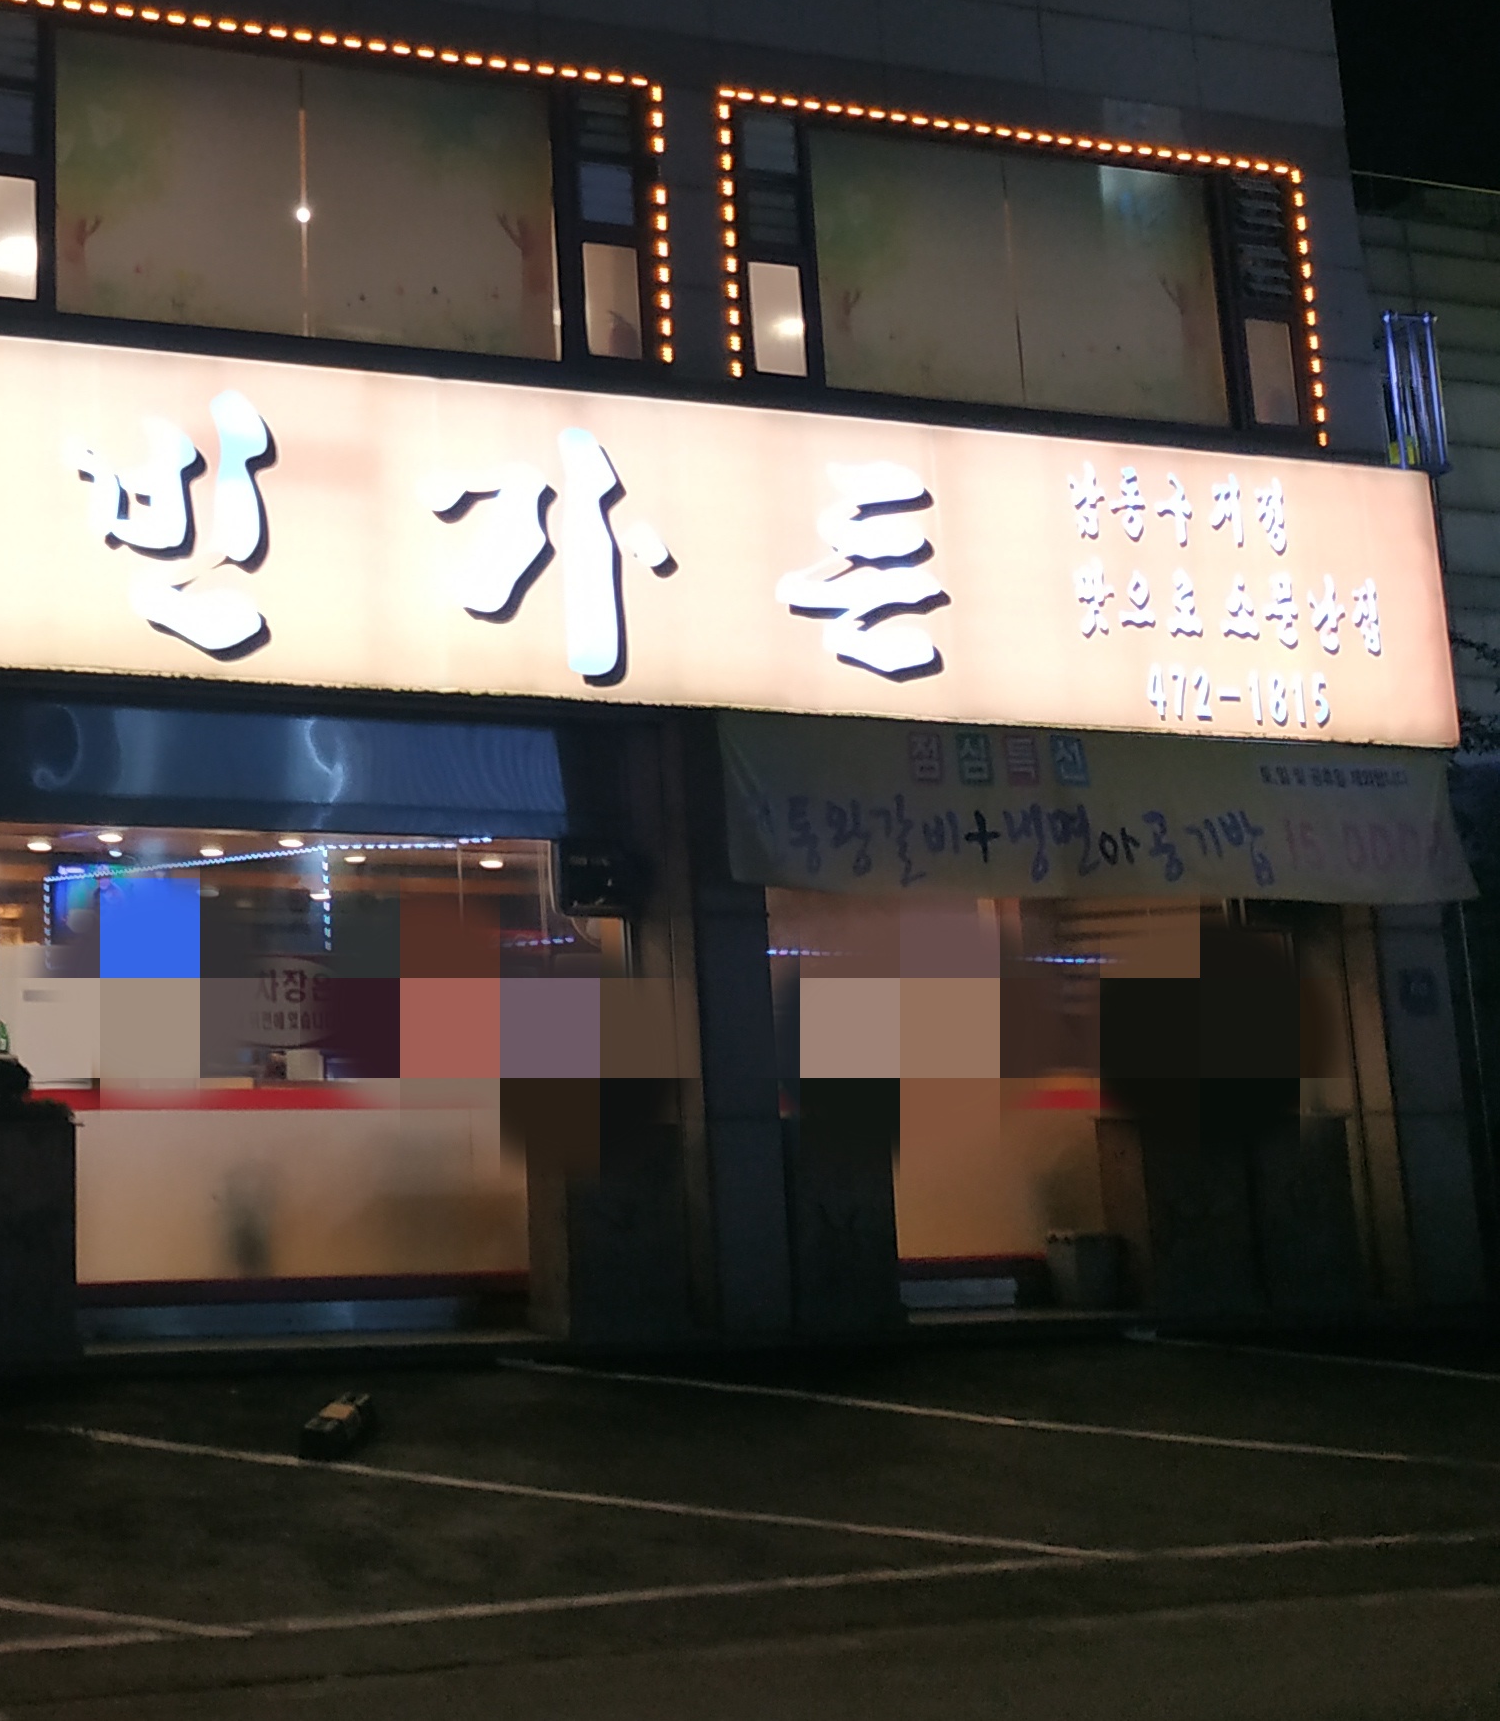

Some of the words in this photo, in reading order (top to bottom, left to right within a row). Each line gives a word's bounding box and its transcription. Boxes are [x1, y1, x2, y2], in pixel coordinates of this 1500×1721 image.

[1067, 461, 1194, 548] 남동구
[1071, 554, 1204, 640] 맛으로
[1220, 570, 1383, 657] 소문난집
[1146, 662, 1332, 729] 472-1815
[909, 731, 1089, 787] 점심특선
